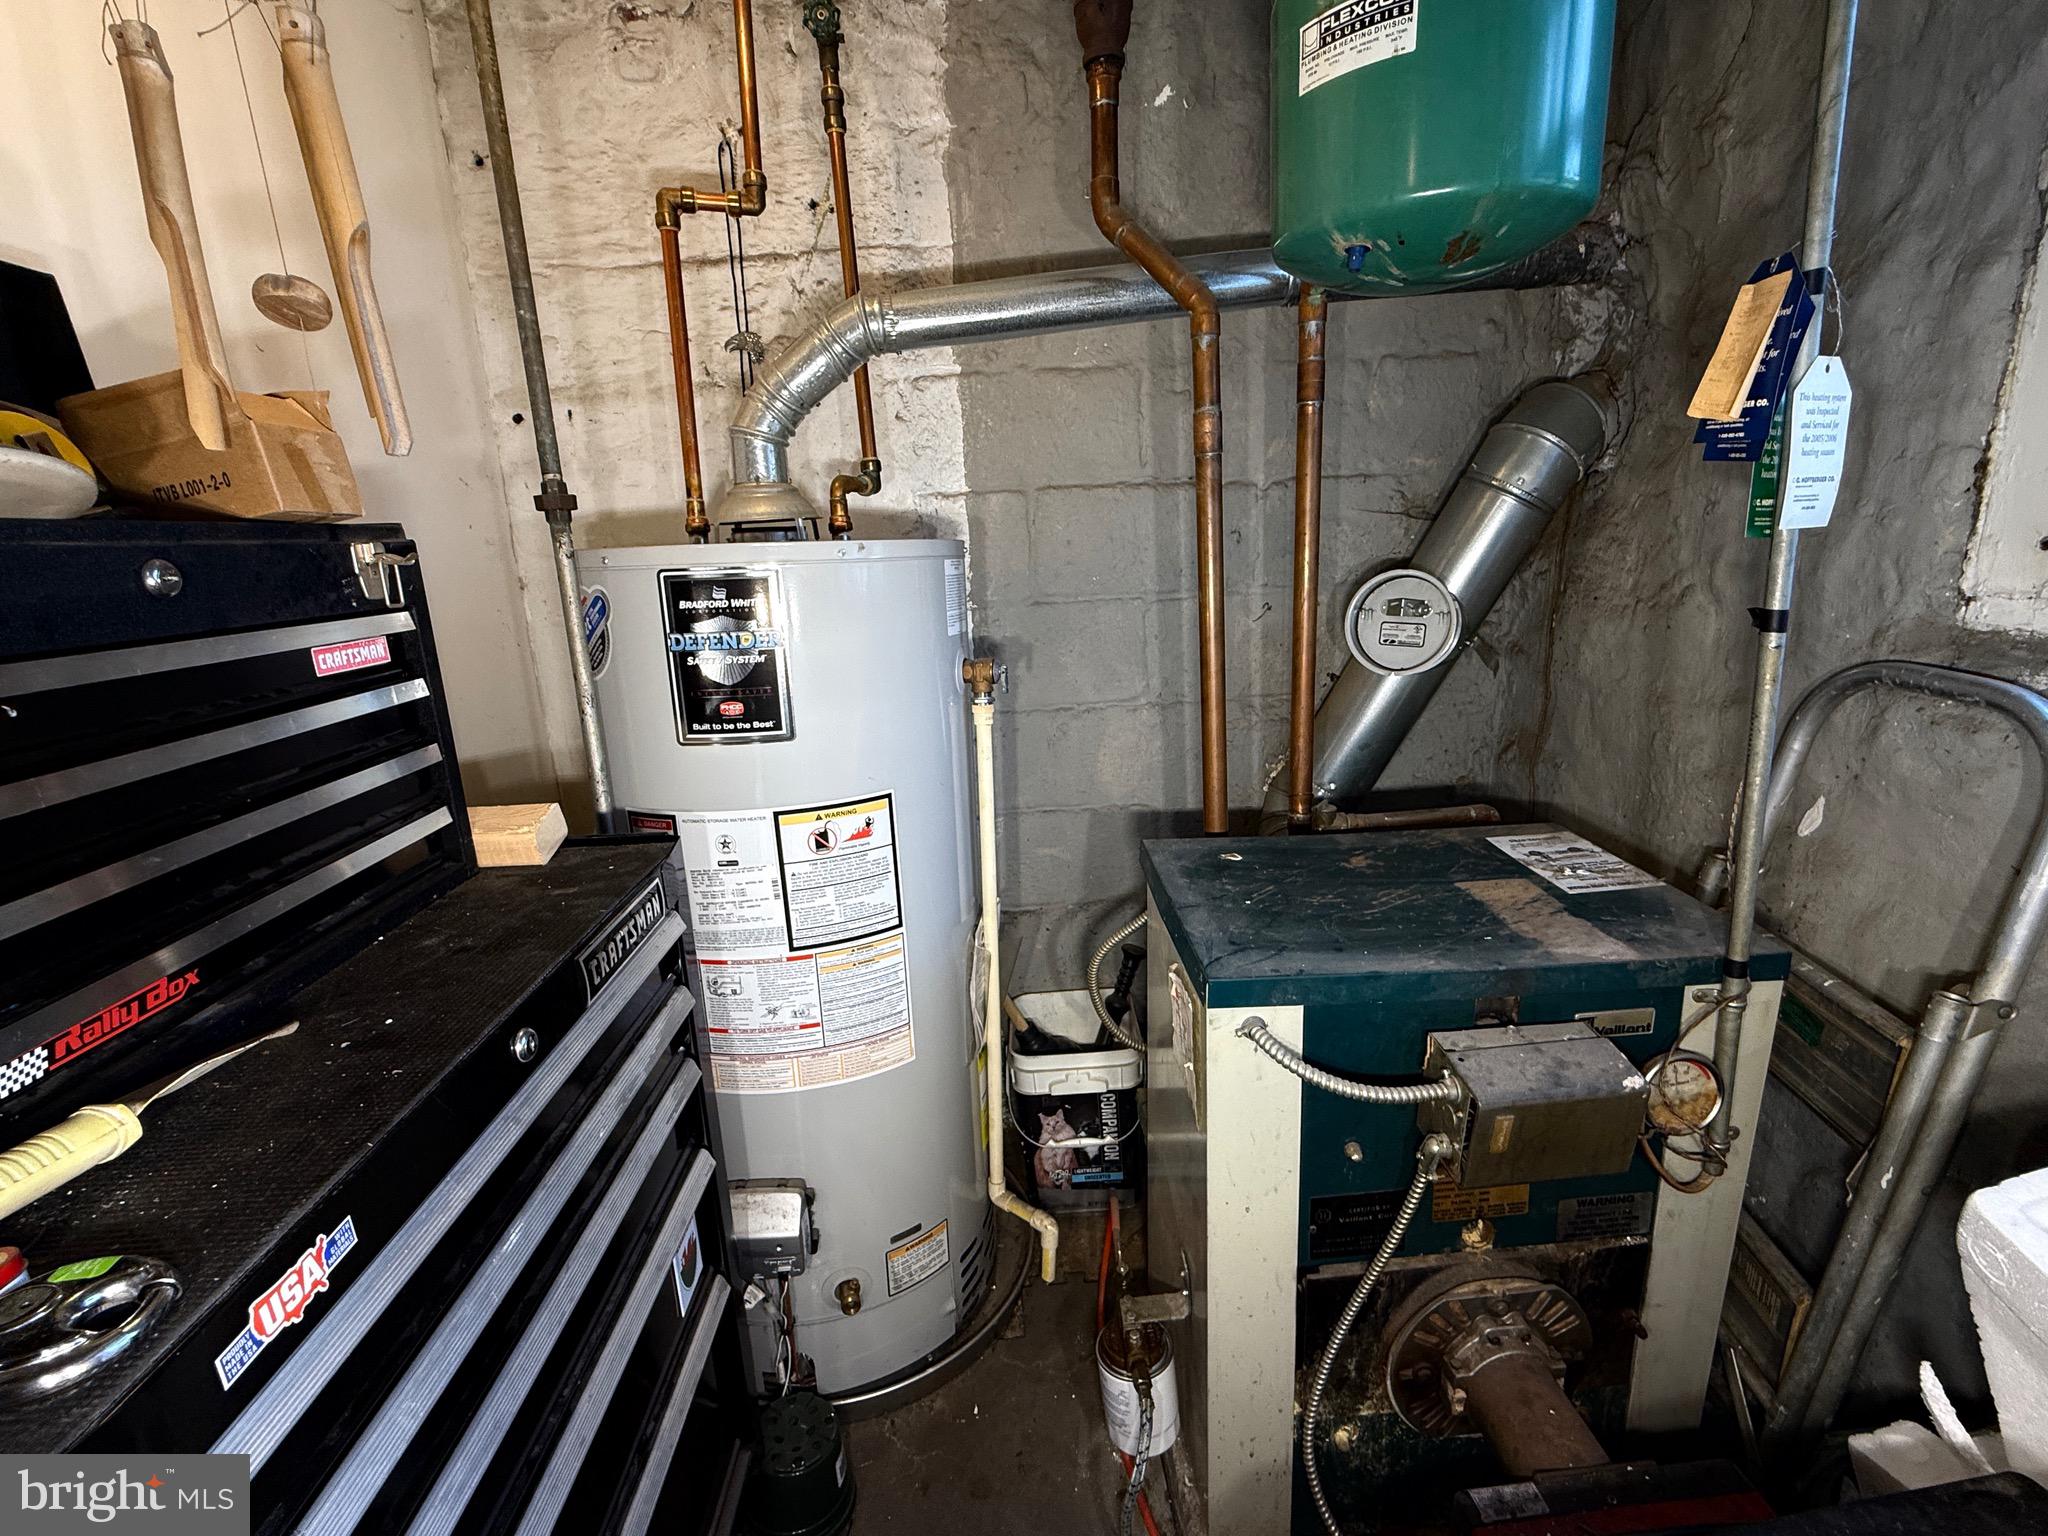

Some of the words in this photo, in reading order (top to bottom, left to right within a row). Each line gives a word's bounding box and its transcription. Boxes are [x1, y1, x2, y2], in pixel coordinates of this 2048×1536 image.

[1320, 4, 1410, 47] INDUSTRIES
[1301, 46, 1332, 68] PLUMBING
[1339, 29, 1373, 49] HEATING
[1374, 15, 1413, 34] DIVISION
[1756, 398, 1769, 407] CO.
[1812, 392, 1831, 404] heating
[1817, 407, 1840, 417] Inspected
[1812, 420, 1832, 430] Serviced
[1801, 448, 1819, 459] heating
[180, 472, 231, 498] L001-2-0
[679, 599, 729, 609] BRADFORD
[731, 598, 761, 608] WHIT
[669, 631, 782, 651] DEFENDER
[318, 643, 385, 670] CRAFTSMAN
[693, 723, 711, 731] Built
[713, 722, 722, 730] to
[723, 722, 735, 730] be
[736, 721, 751, 729] the
[753, 720, 774, 728] Best
[643, 820, 667, 828] DANGER
[824, 808, 858, 820] WARNING
[590, 893, 661, 986] CRAFTSMAN
[1101, 1093, 1120, 1161] COMPANON
[1577, 1194, 1636, 1208] WARNING
[331, 1229, 352, 1255] GLOBAL
[335, 1223, 351, 1241] WITH
[328, 1237, 354, 1266] MATERIALS
[258, 1253, 325, 1337] USA
[222, 1333, 251, 1366] PROUDLY
[224, 1349, 244, 1373] MADE
[244, 1338, 254, 1351] IN
[227, 1362, 243, 1380] THE
[243, 1345, 258, 1364] USA
